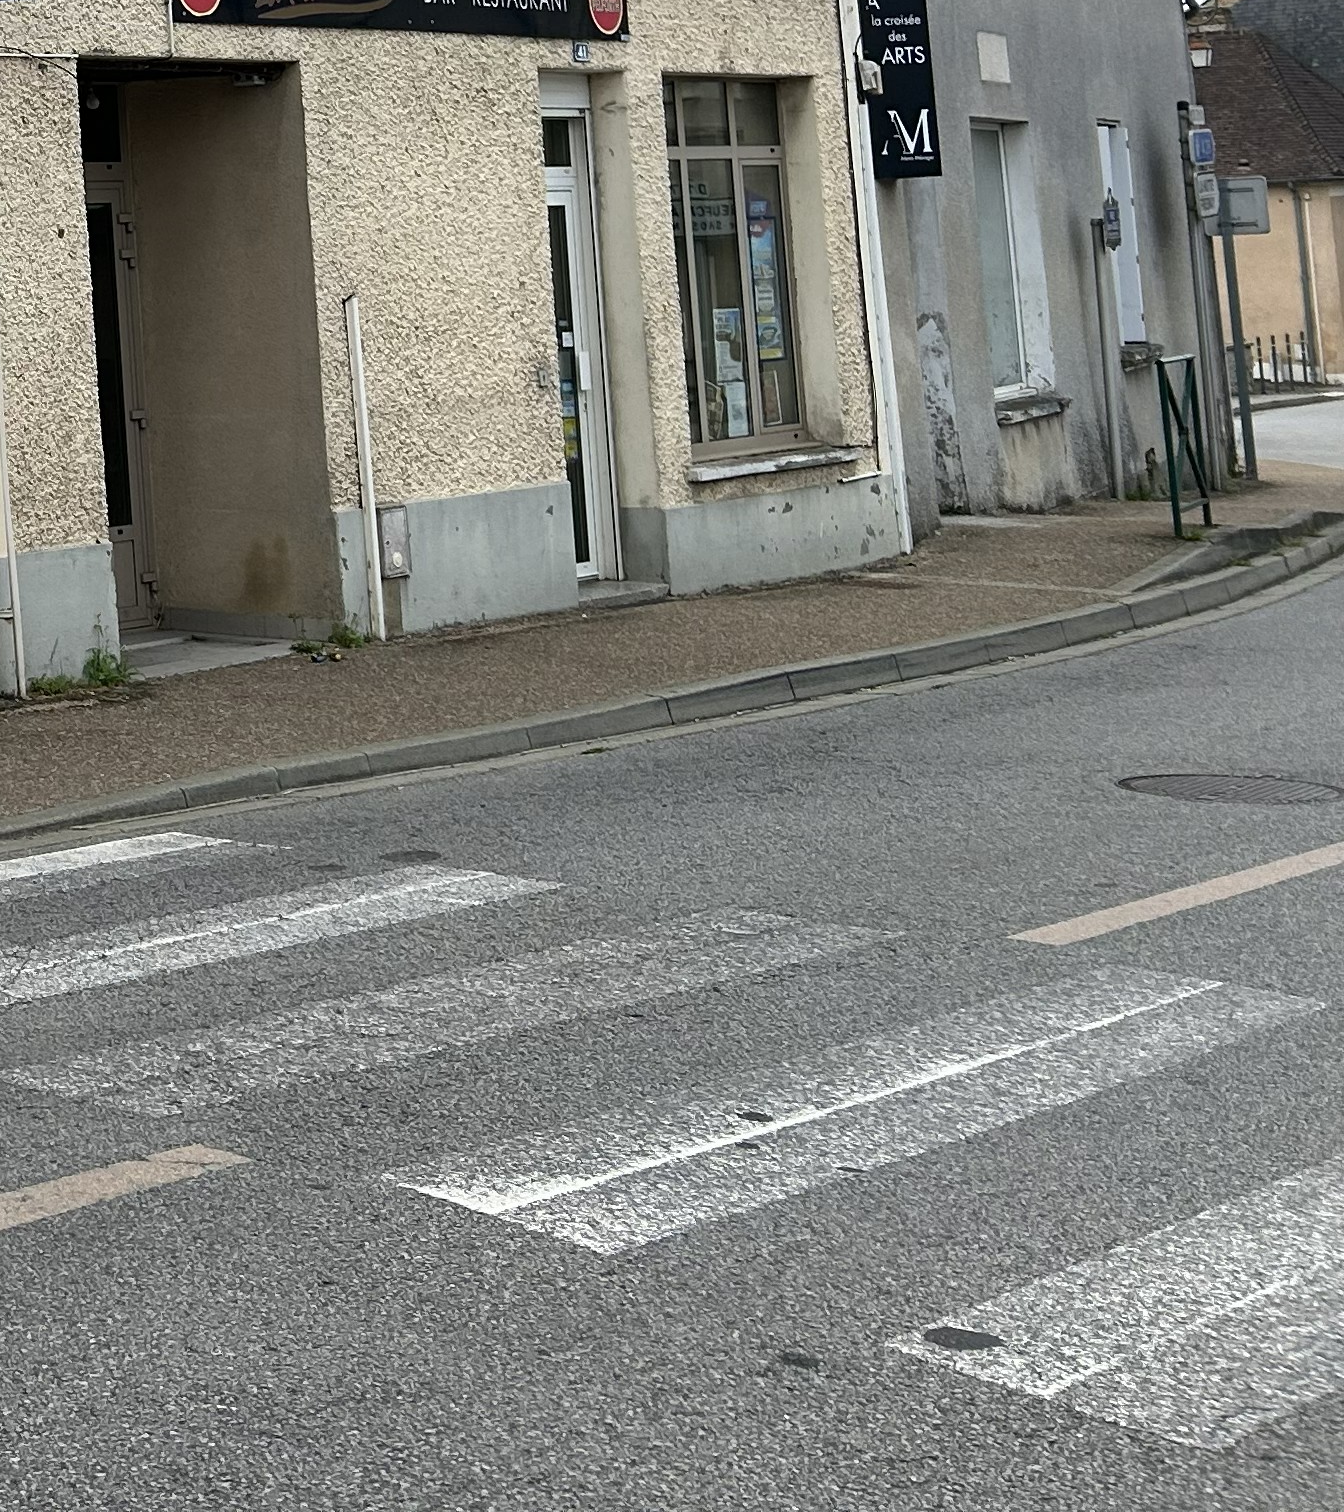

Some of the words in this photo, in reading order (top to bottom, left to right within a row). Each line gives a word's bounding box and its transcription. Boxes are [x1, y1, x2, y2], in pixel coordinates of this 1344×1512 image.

[871, 13, 882, 27] la
[884, 13, 921, 26] croisée
[888, 29, 907, 42] des
[881, 45, 925, 65] ARTS
